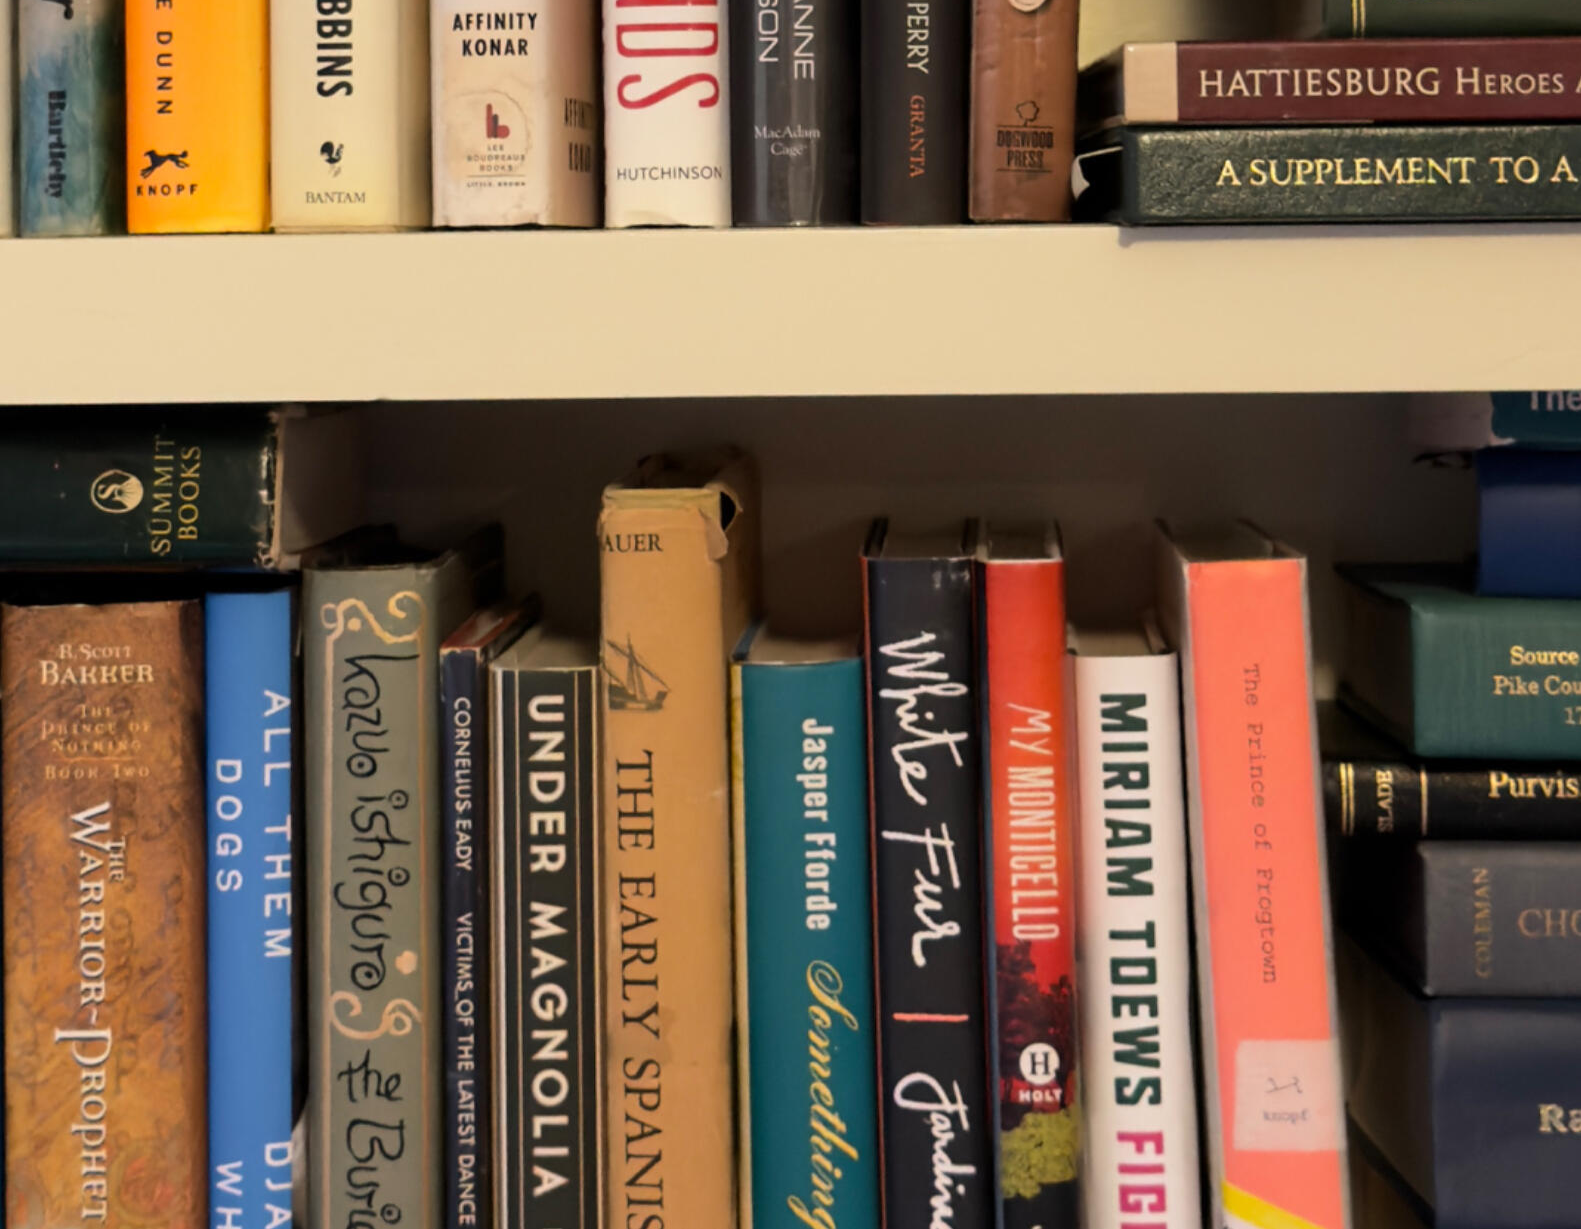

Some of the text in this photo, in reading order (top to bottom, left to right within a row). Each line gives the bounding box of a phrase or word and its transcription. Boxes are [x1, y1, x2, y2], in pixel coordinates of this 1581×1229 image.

[452, 12, 538, 32] AFFINITY
[461, 39, 529, 57] KONAR
[906, 2, 930, 74] PERRY
[156, 31, 173, 115] DUNN
[1199, 66, 1440, 98] HATTIESBURG
[1455, 67, 1565, 96] HEROES
[616, 165, 723, 182] HUTCHINSON
[909, 94, 926, 179] GRANTA
[1216, 154, 1579, 187] A SUPPLEMENT TO A
[136, 183, 198, 197] KNOPF
[305, 190, 366, 205] BANTAM
[150, 434, 175, 556] SUMMIT
[177, 446, 200, 541] BOOKS
[603, 533, 664, 553] AUER
[39, 659, 155, 686] BAKKER
[1493, 675, 1540, 695] Pike
[1509, 645, 1580, 666] Source
[453, 697, 473, 872] CORNELIUS EADY
[615, 749, 655, 852] THE
[796, 718, 834, 823] Jasper
[878, 630, 969, 969] White Fur
[1489, 770, 1580, 799] Purvis
[215, 759, 244, 893] DOGS
[263, 689, 293, 959] ALL THEM
[1007, 702, 1060, 942] MY MONTICELLO
[1243, 663, 1277, 985] The Prince of Frogtown
[804, 832, 838, 931] Fforde
[1472, 867, 1492, 980] COLEMAN
[528, 694, 569, 1199] UNDER MAGNOLIA
[618, 872, 661, 1040] EARLY
[1099, 693, 1168, 1229] MIRIAM TOEWS FIG
[456, 912, 476, 1226] VICTIMS OF THE LATEST DANCE
[1018, 1088, 1063, 1104] HOLT
